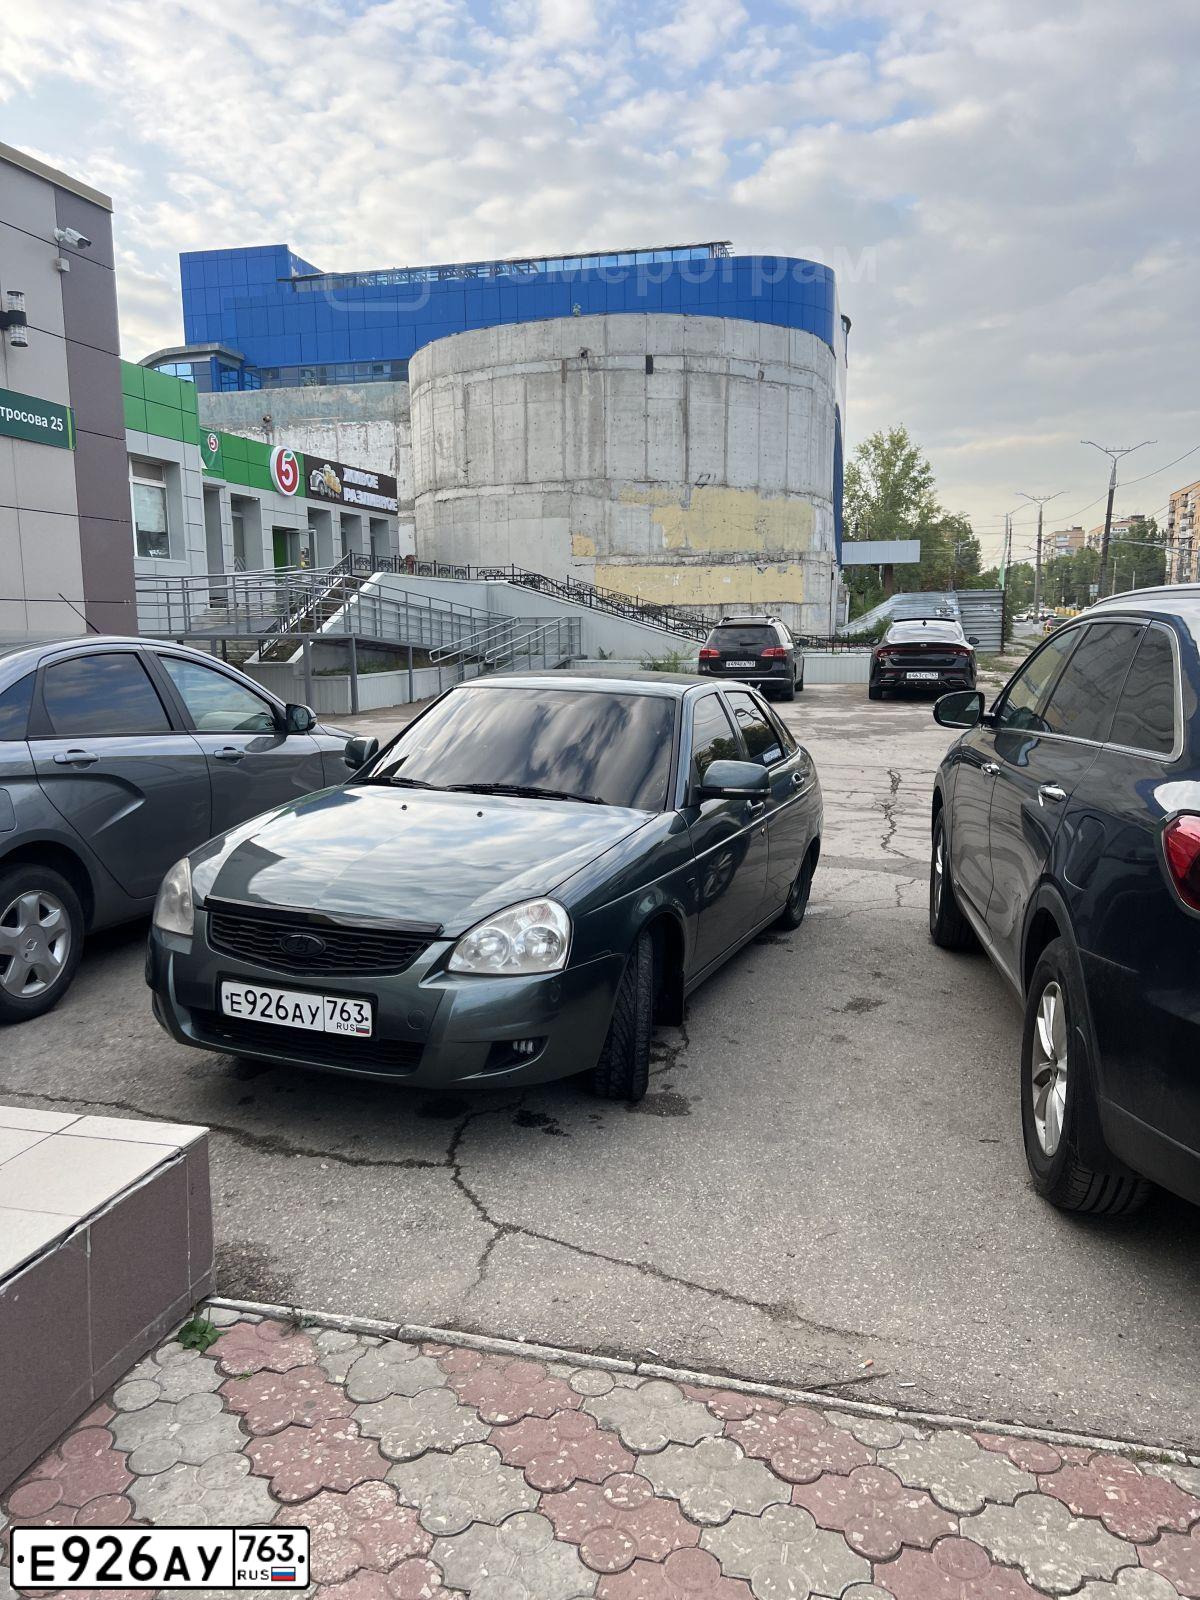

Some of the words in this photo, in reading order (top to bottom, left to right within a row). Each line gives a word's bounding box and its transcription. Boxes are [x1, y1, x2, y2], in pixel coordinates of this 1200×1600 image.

[50, 416, 63, 431] 25
[230, 990, 320, 1025] Е926АУ
[326, 1000, 364, 1023] 763
[336, 1022, 356, 1032] RUS
